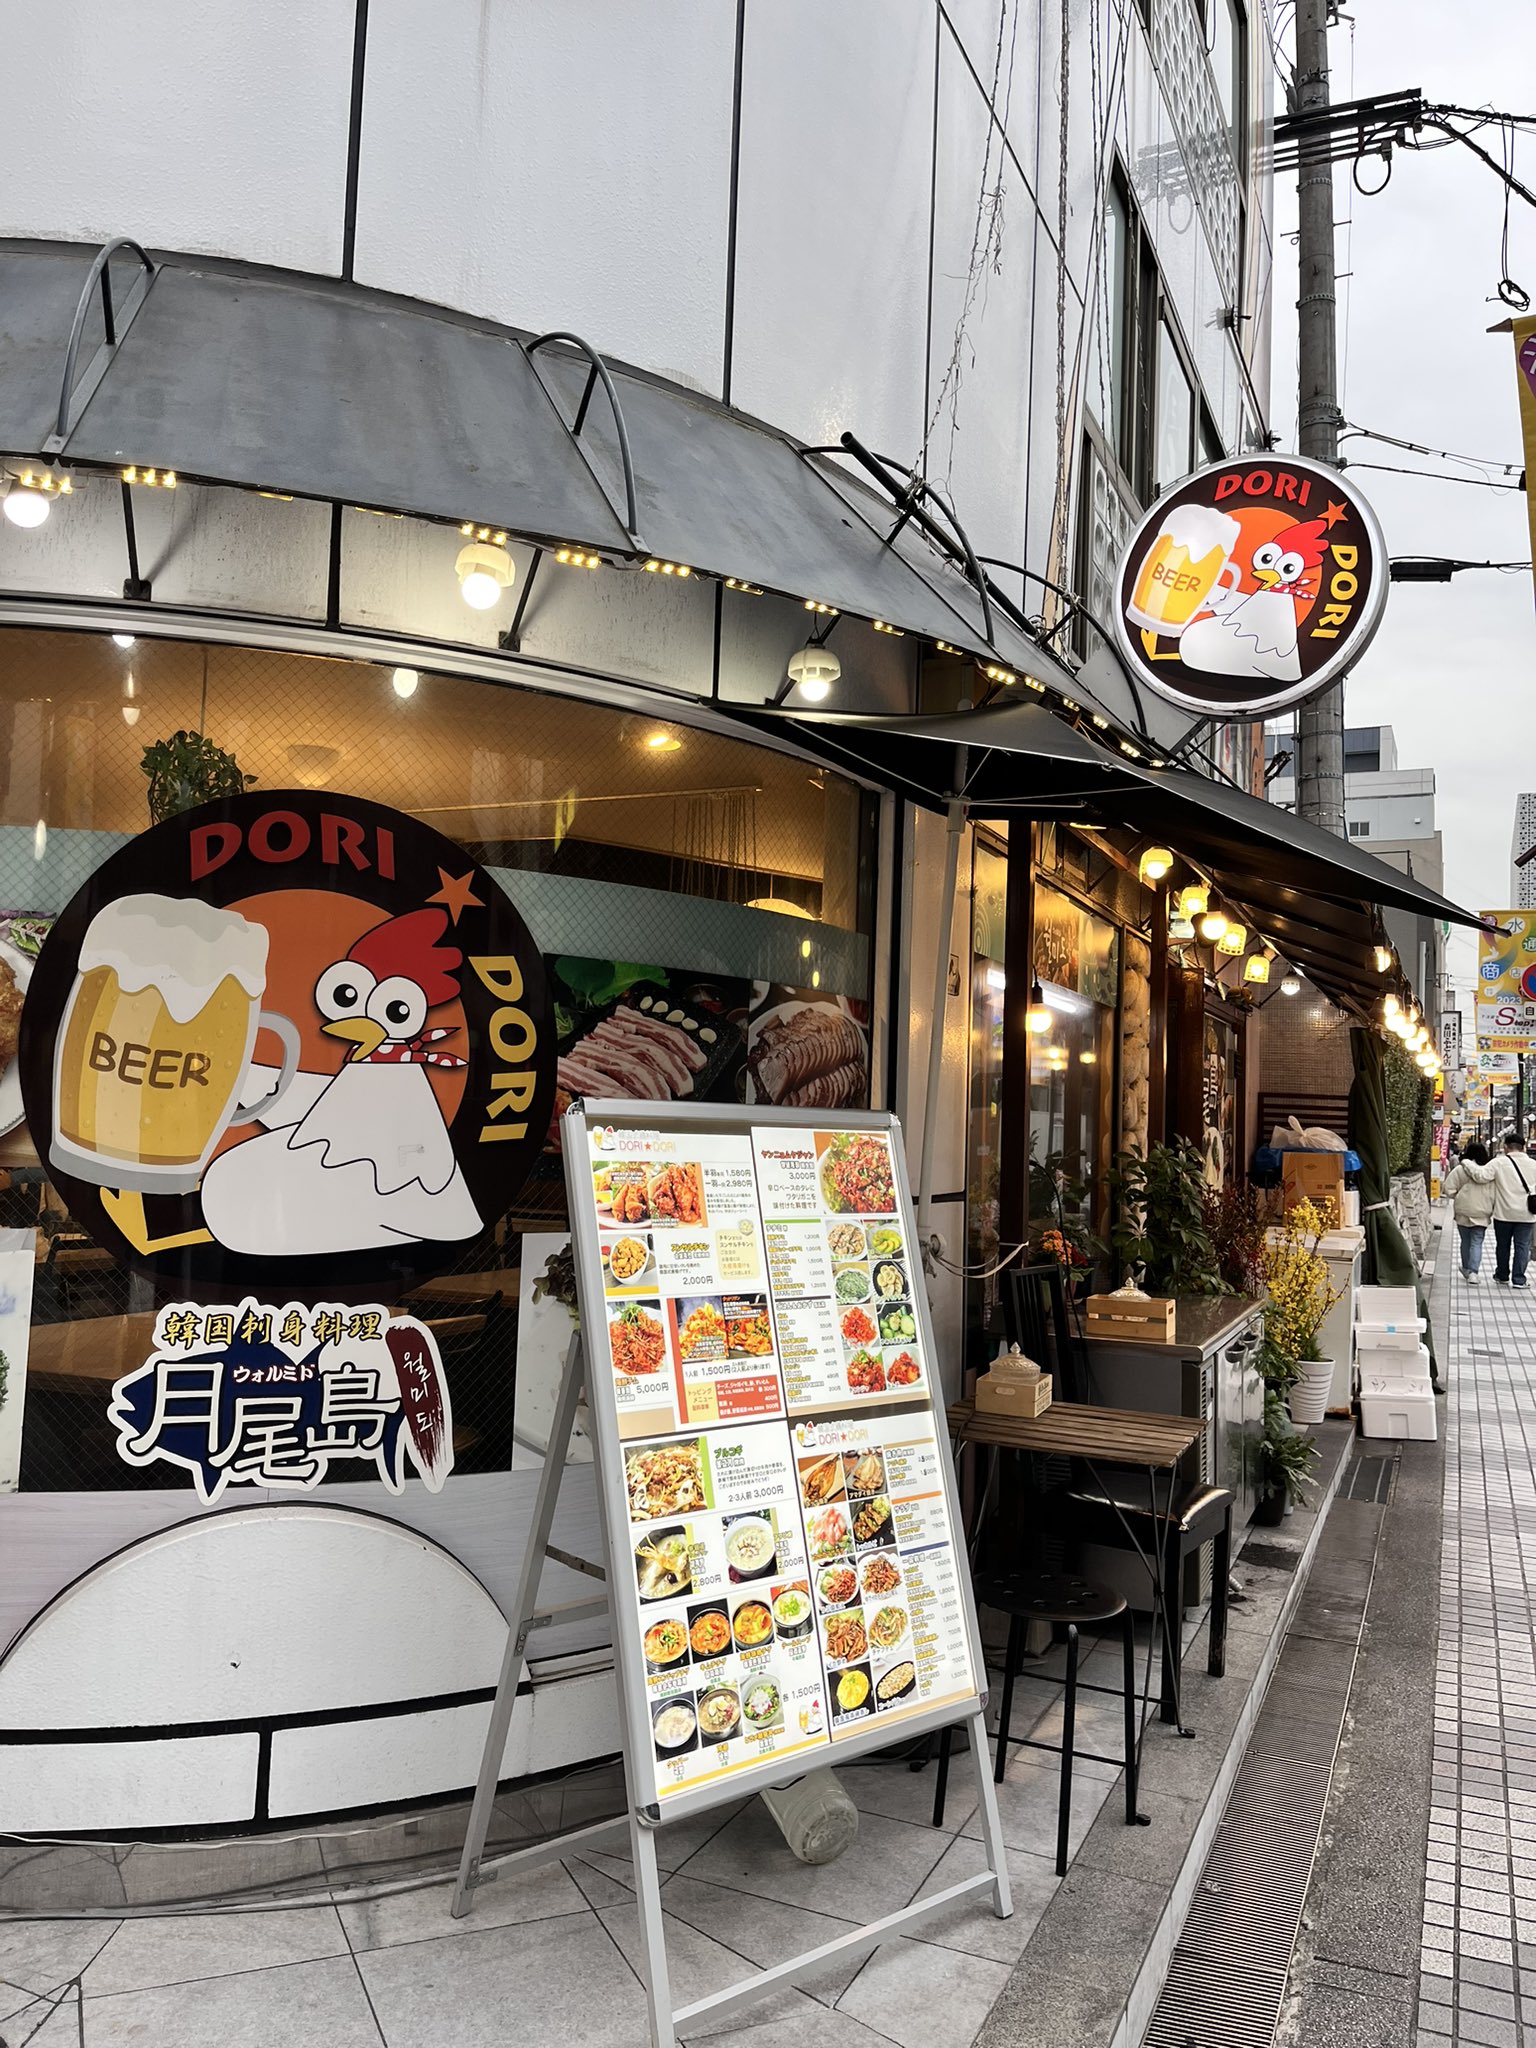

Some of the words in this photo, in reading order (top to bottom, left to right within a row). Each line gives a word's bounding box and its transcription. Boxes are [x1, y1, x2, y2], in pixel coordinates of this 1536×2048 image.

[1214, 470, 1311, 507] DORI
[1152, 562, 1202, 593] BEER
[1310, 545, 1358, 639] DORI
[189, 810, 396, 882] DORI
[1508, 918, 1522, 932] 水
[1482, 961, 1500, 980] 商
[1496, 996, 1522, 1004] 2023
[468, 955, 537, 1143] DORI
[89, 1031, 211, 1089] BEER
[619, 1141, 643, 1151] DORI
[683, 1275, 714, 1285] 2,000円
[162, 1311, 382, 1349] 韓国刺身料理
[233, 1364, 317, 1383] ウォルミド
[701, 1365, 731, 1376] 1,500円
[403, 1351, 434, 1433] 월미도
[636, 1382, 669, 1394] 5,000円
[128, 1361, 400, 1478] 月尾島
[819, 1433, 839, 1445] DORI
[754, 1485, 784, 1498] 3,000円
[778, 1557, 804, 1568] 2,000円
[693, 1574, 722, 1587] 2,800円
[792, 1683, 821, 1699] 1,500円
